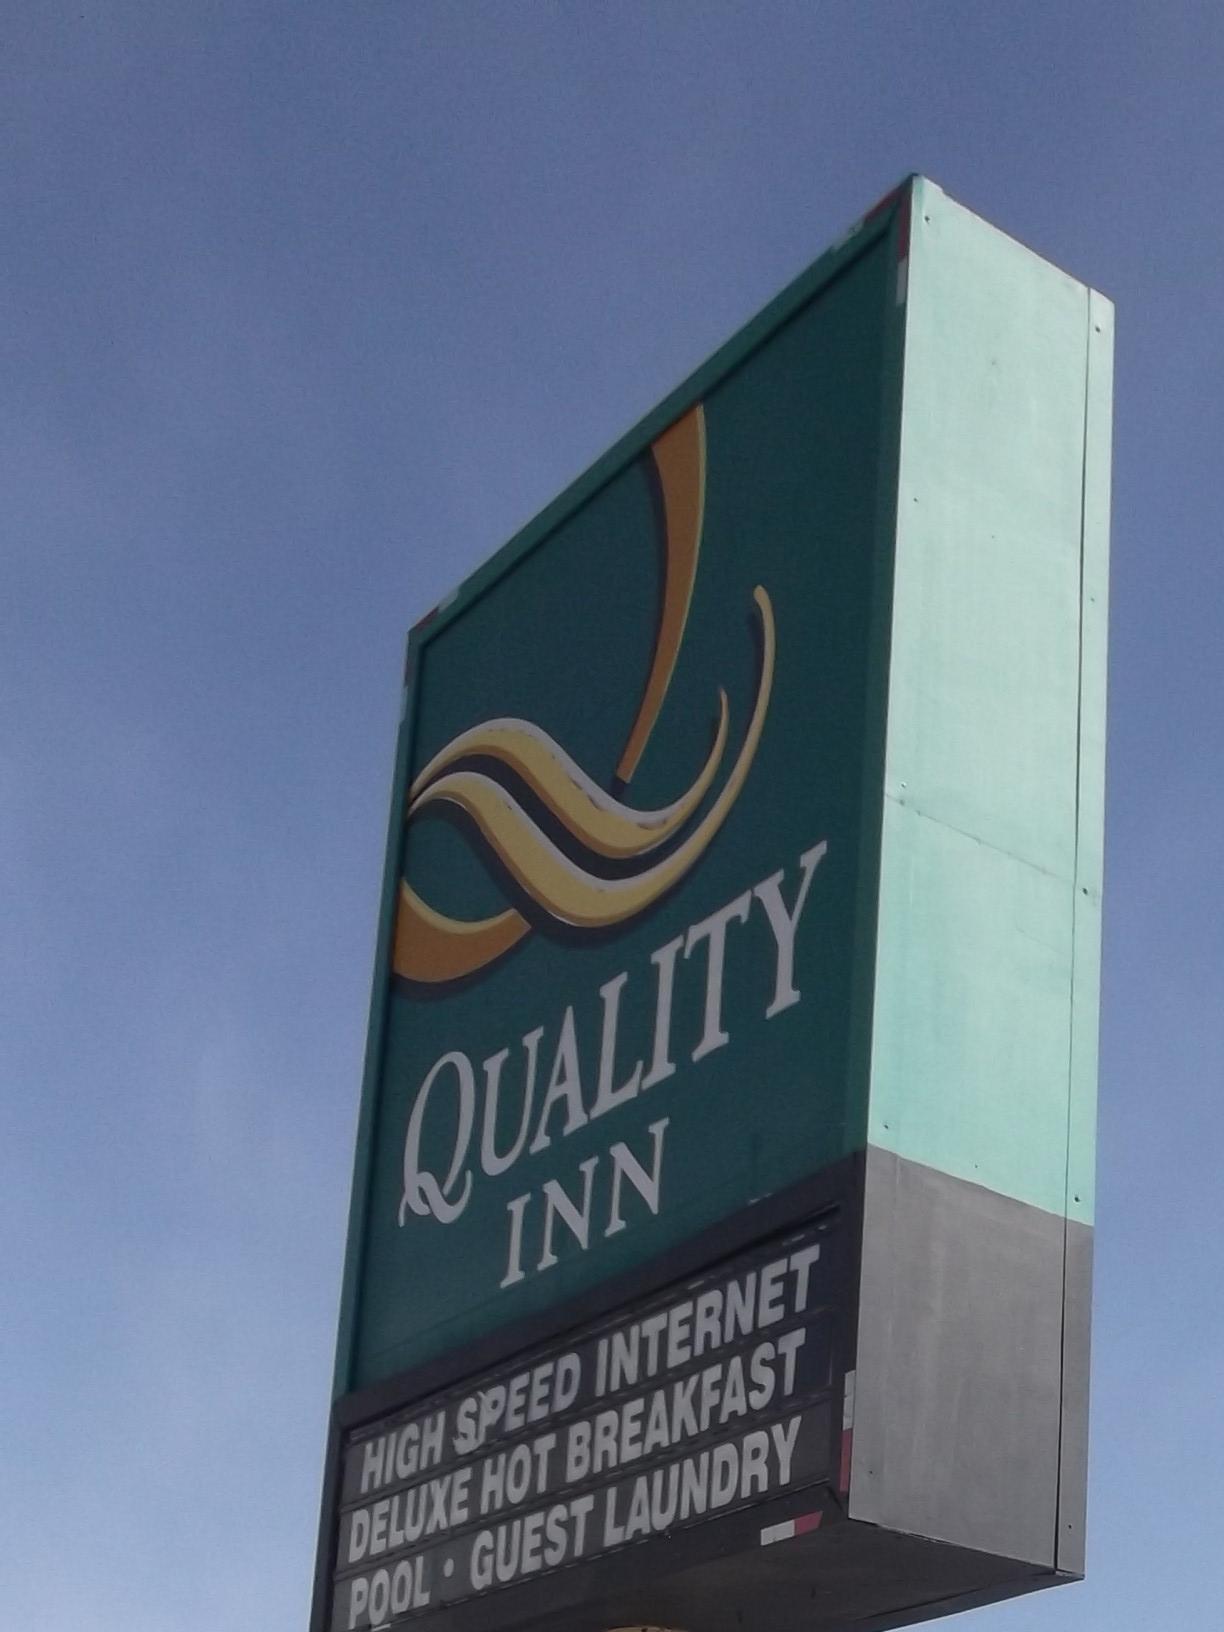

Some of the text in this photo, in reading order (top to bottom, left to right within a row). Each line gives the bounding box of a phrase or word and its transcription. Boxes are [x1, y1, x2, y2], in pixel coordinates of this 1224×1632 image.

[399, 838, 828, 1228] QUALITY
[500, 1117, 670, 1288] INN
[348, 1328, 806, 1563] DELUXE HOT BREAKFAST
[360, 1244, 821, 1494] HIGH SPEED INTERNET
[347, 1416, 803, 1631] POOL GUEST LAUNDRY
